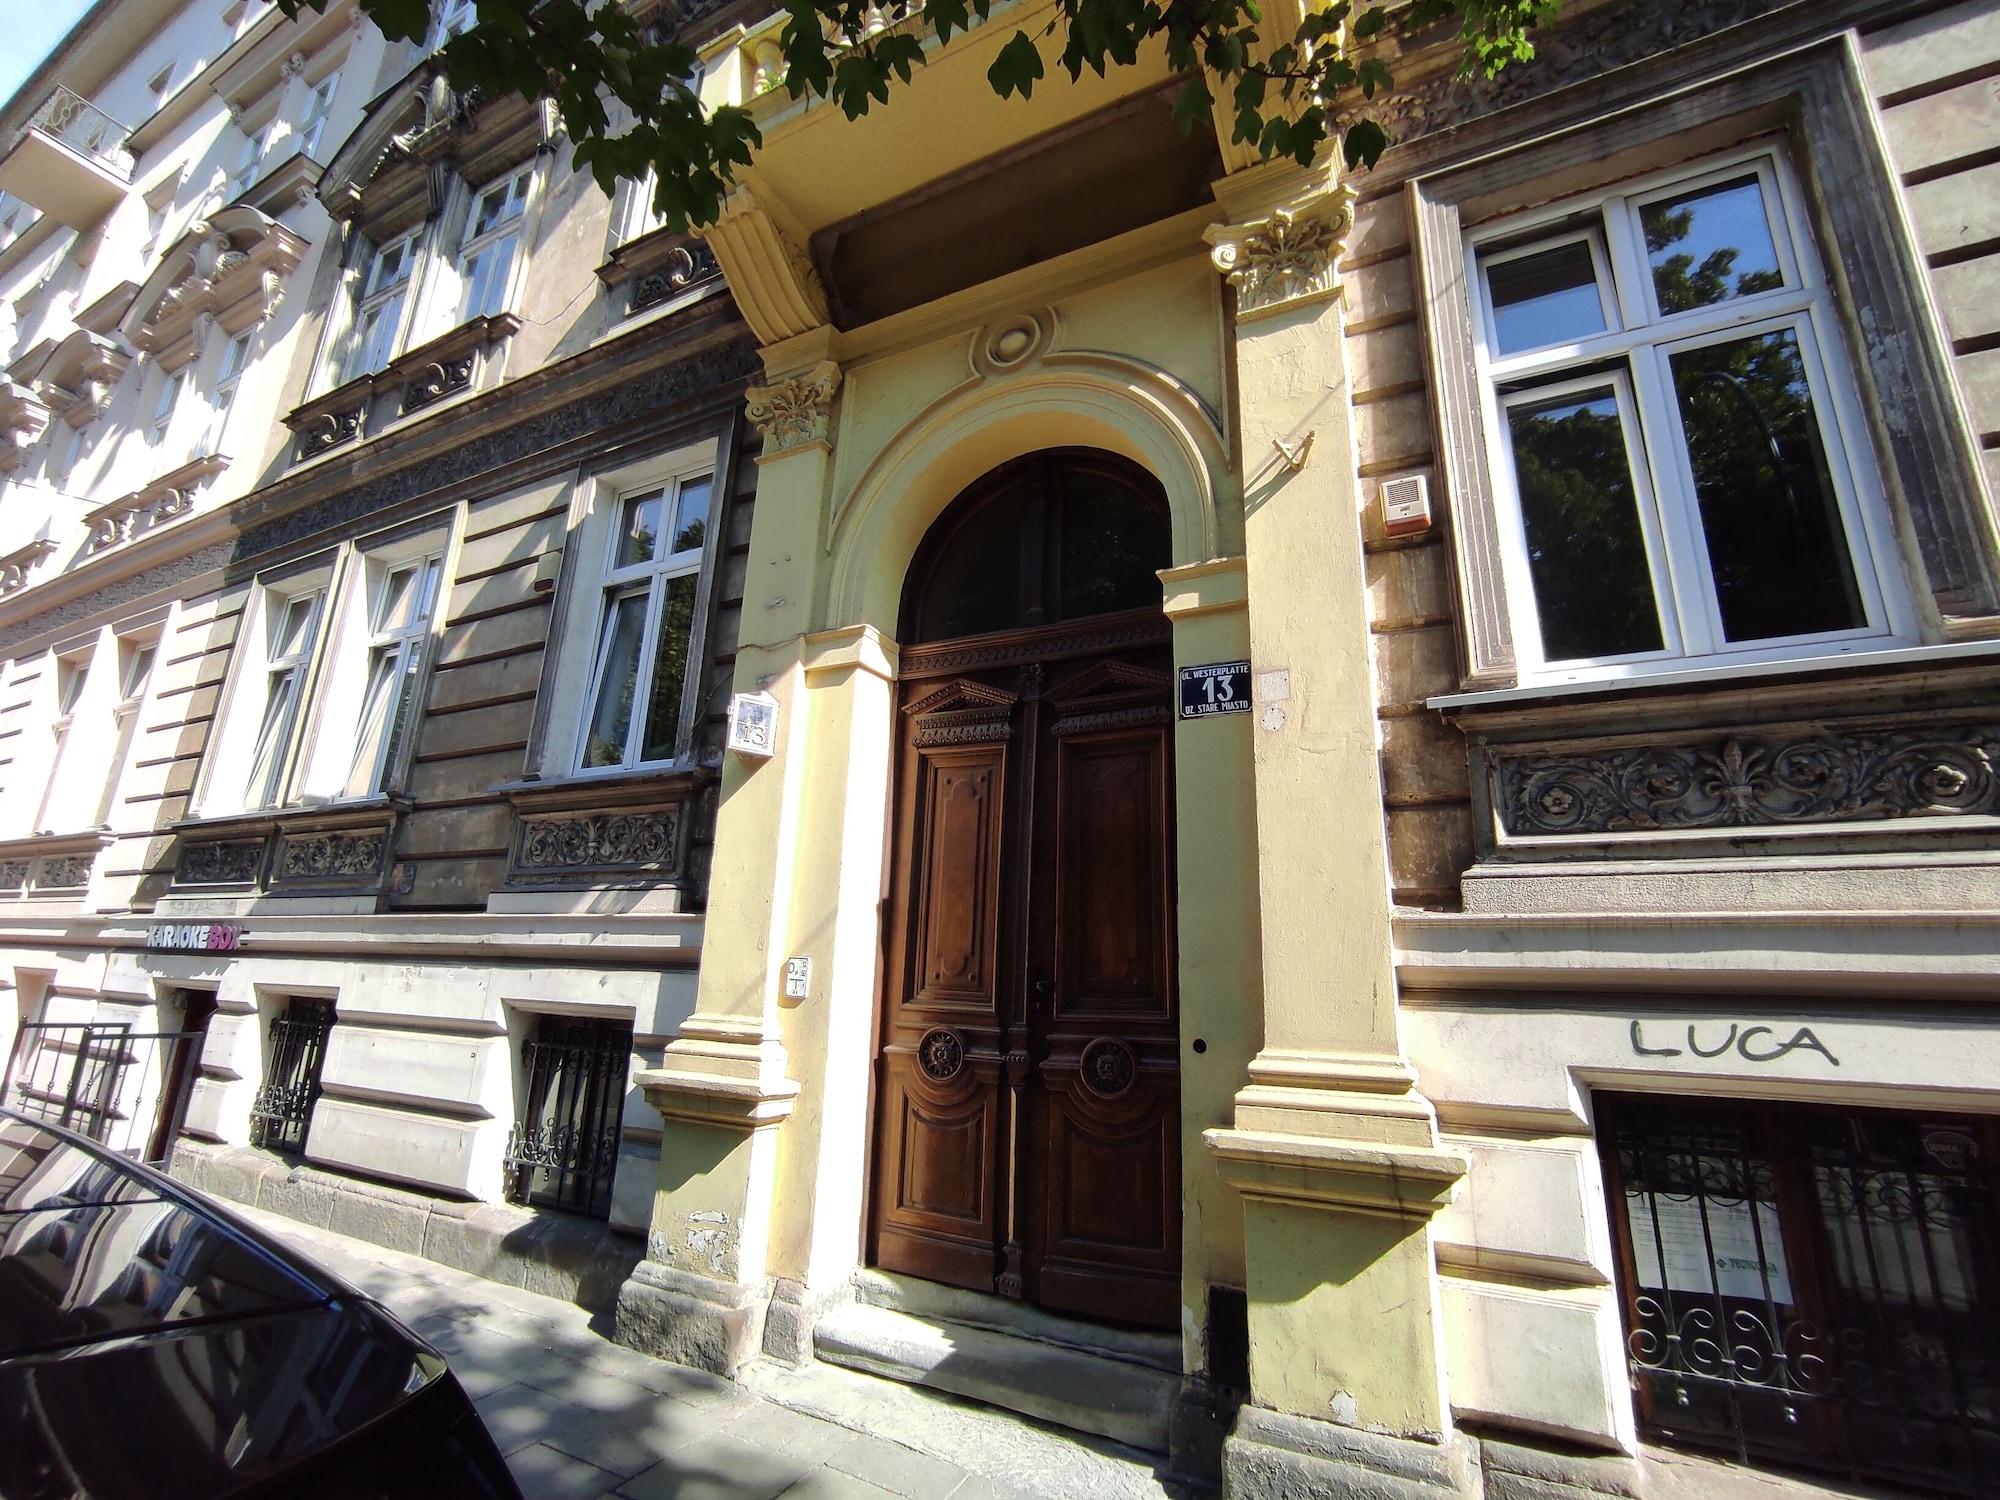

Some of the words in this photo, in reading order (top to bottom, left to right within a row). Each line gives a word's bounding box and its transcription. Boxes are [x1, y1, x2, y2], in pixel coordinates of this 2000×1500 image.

[1193, 666, 1249, 678] WESTERPLATTE
[1202, 675, 1233, 703] 13
[1198, 703, 1219, 713] STARE
[1222, 700, 1248, 710] MIASTO
[743, 725, 765, 746] 13
[147, 924, 210, 949] KARAOKE
[1630, 1020, 1841, 1067] LUCA
